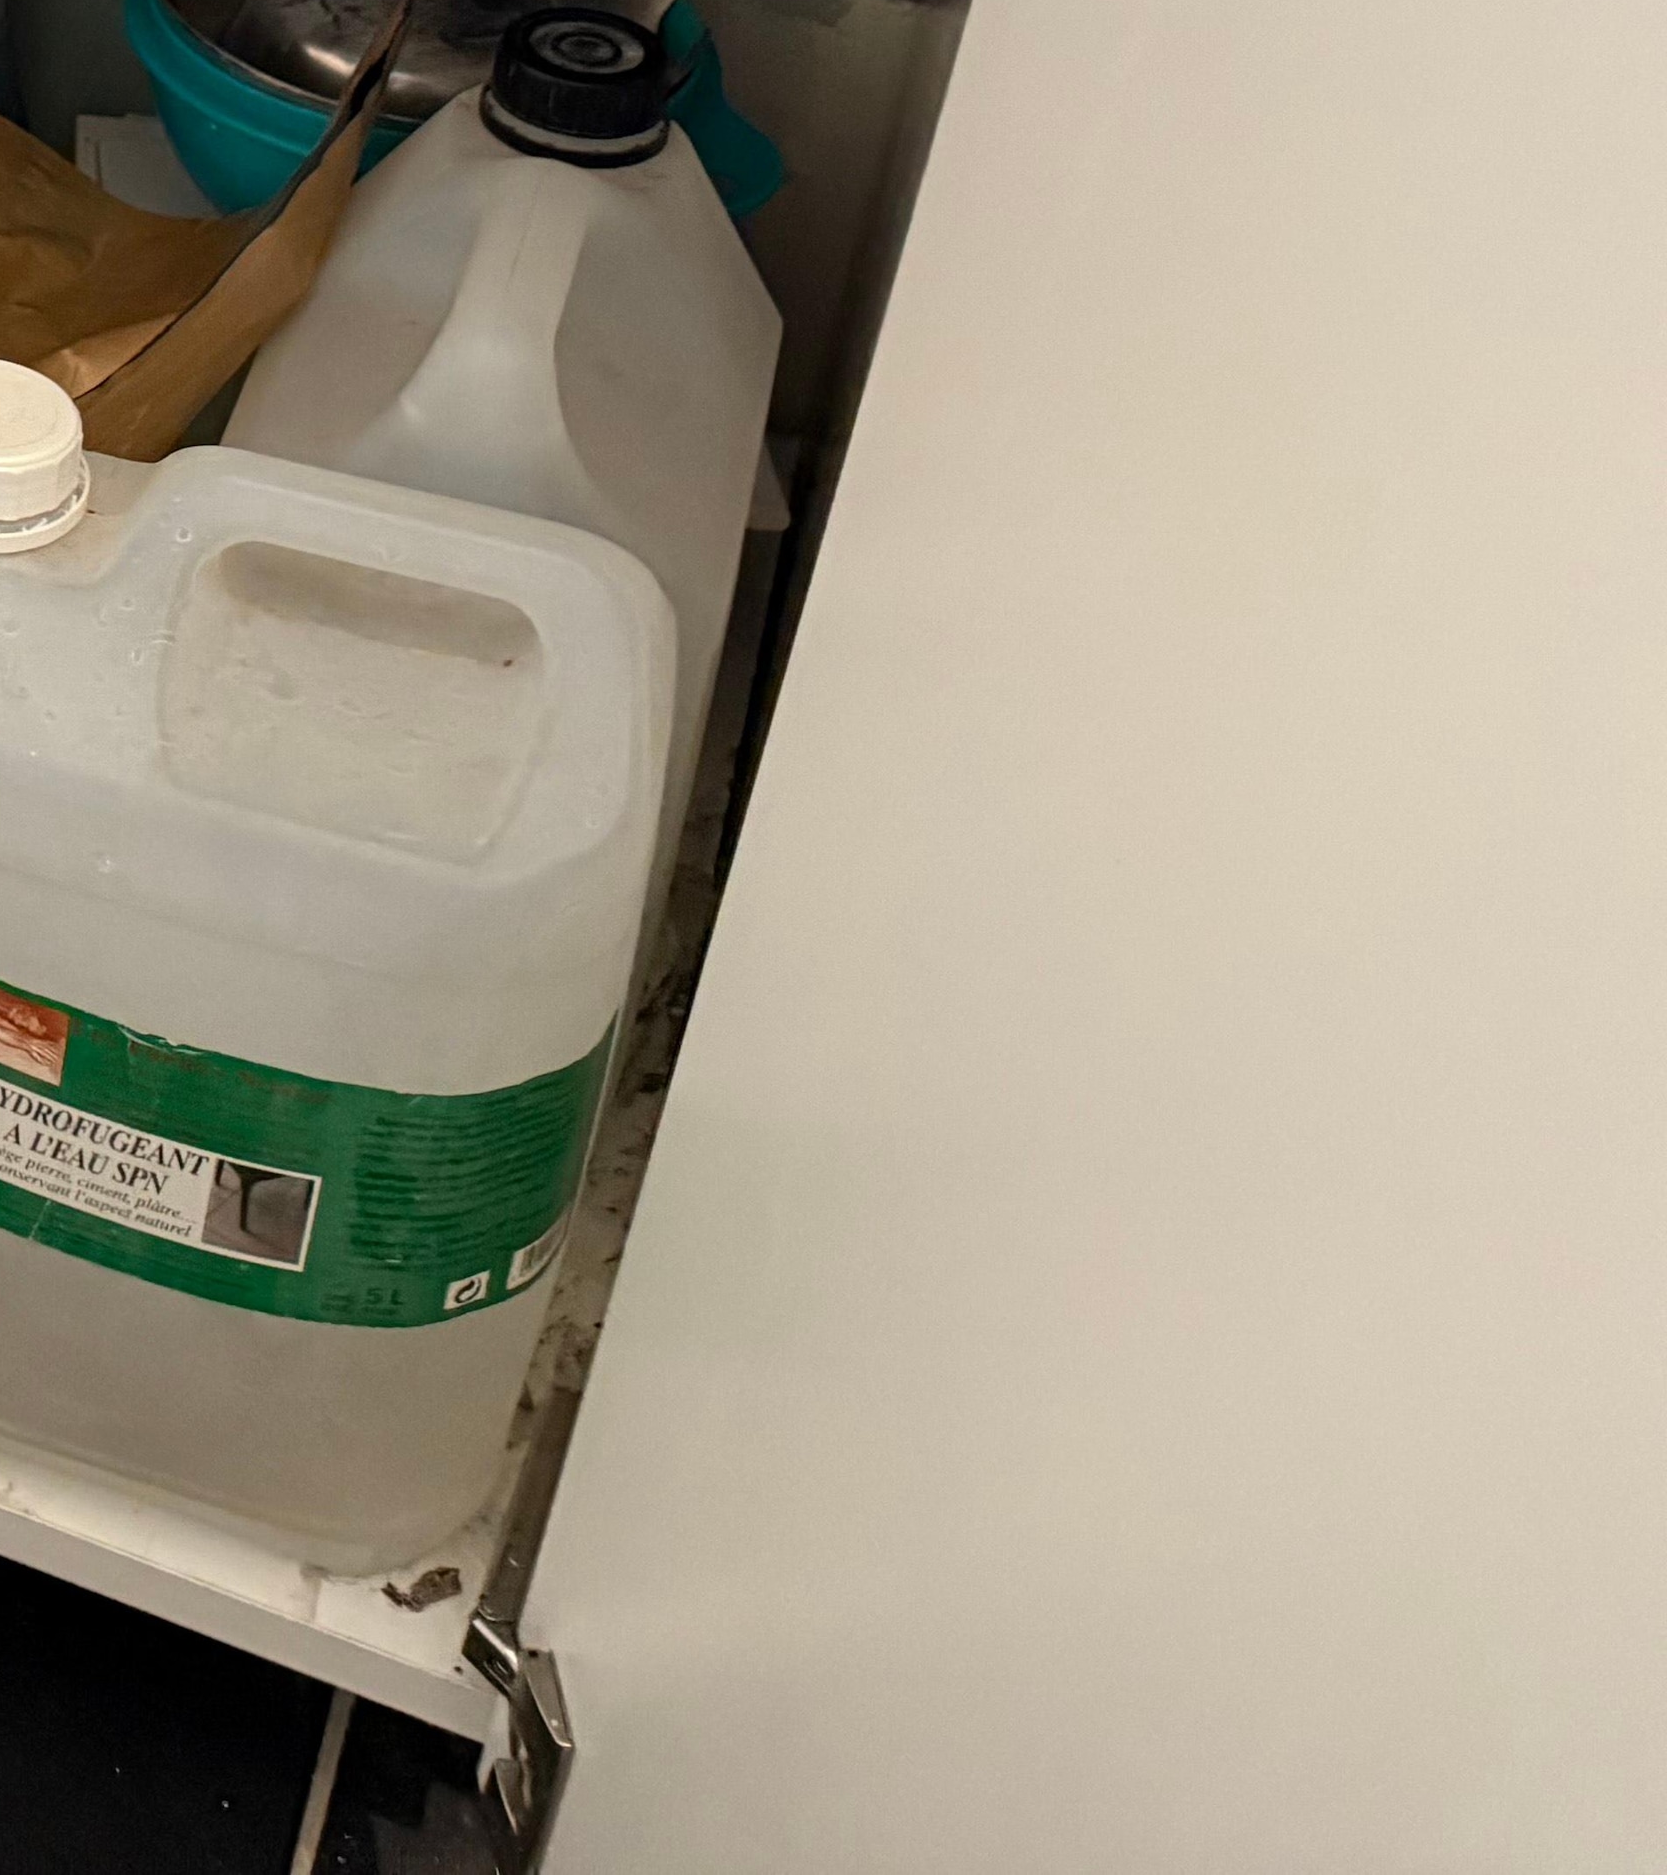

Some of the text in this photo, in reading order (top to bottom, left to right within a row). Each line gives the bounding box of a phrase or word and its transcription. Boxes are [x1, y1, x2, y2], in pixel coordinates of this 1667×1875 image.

[3, 1123, 170, 1196] A L'EAU SPN
[25, 1157, 73, 1185] pierre,
[77, 1177, 131, 1205] ciment,
[74, 1188, 133, 1222] l'aspect
[134, 1212, 193, 1239] naturel
